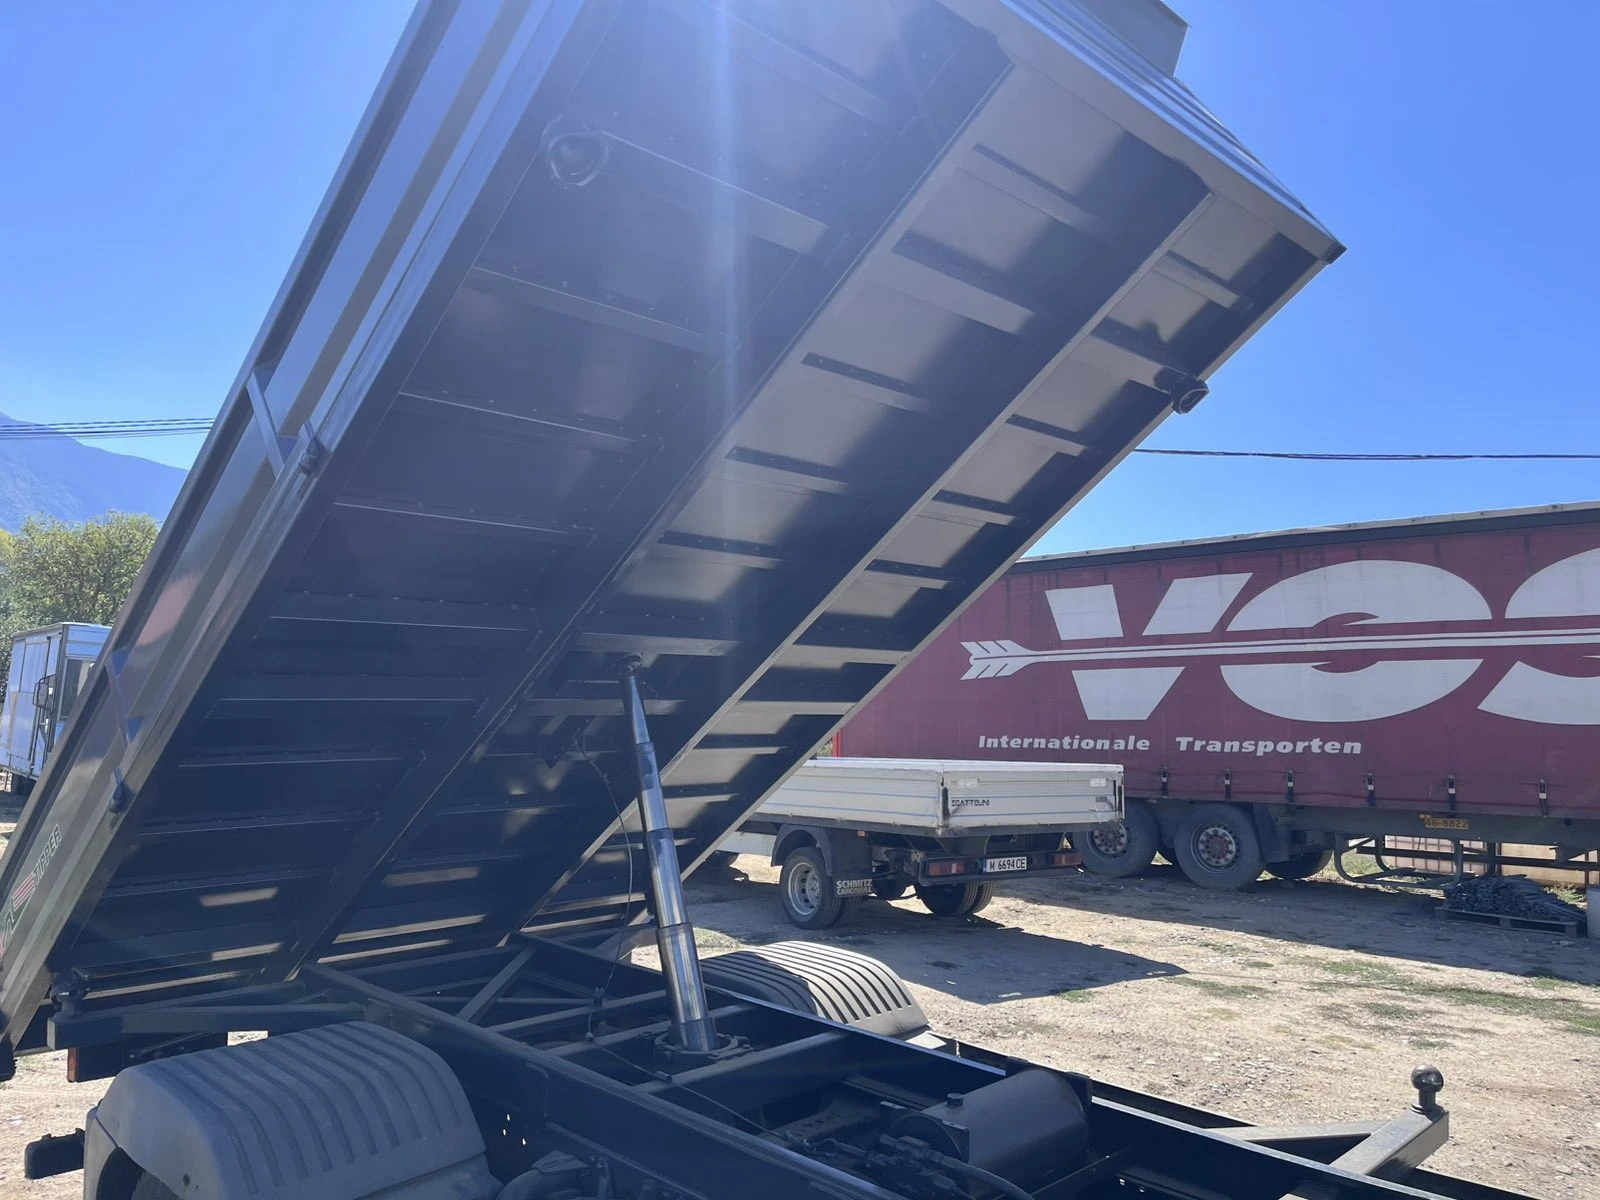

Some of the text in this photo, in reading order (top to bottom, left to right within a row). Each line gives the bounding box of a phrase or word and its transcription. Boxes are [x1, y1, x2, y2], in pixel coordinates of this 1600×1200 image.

[978, 735, 1363, 756] Internationale Transporten
[32, 824, 62, 885] TIPPER
[836, 879, 872, 889] SCHMITZ
